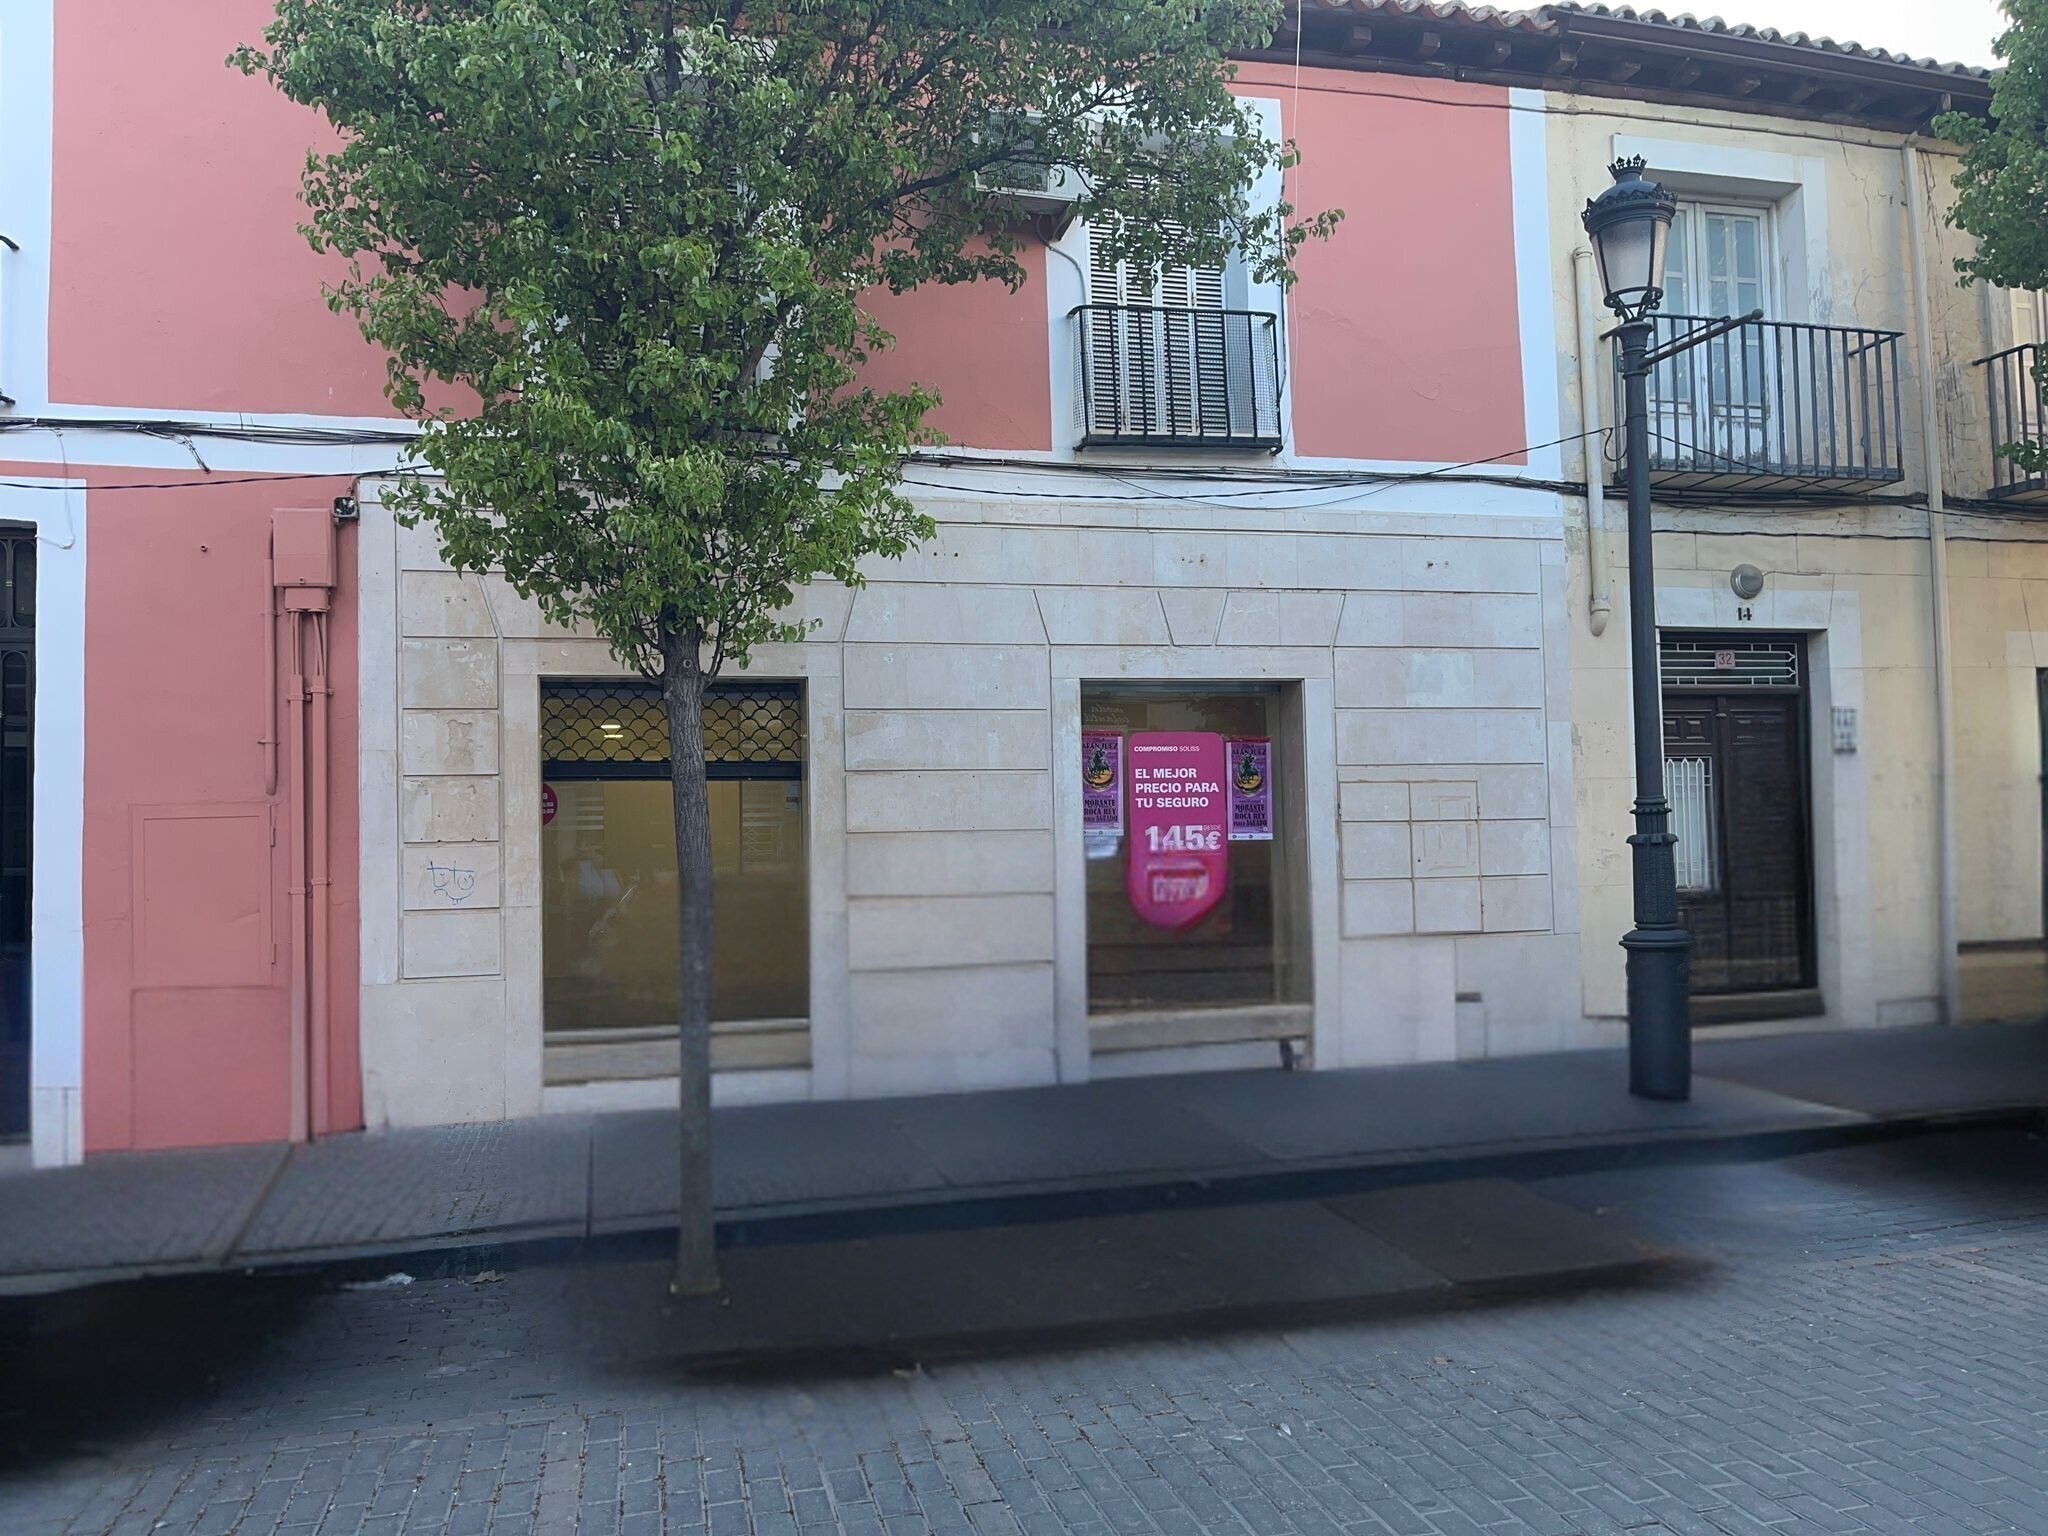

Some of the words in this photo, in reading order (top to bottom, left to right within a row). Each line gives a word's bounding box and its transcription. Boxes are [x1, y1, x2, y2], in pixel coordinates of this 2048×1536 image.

[1737, 607, 1752, 621] 14
[1718, 652, 1733, 665] 32
[1135, 768, 1150, 779] EL
[1153, 768, 1197, 779] MEJOR
[1135, 783, 1182, 794] PRECIO
[1185, 782, 1219, 793] PARA
[1085, 799, 1116, 807] MORANTE
[1135, 798, 1153, 808] TU
[1156, 797, 1209, 808] SEGURO
[1235, 803, 1265, 812] MORANTE
[1084, 808, 1101, 816] ROCA
[1103, 808, 1117, 816] REY
[1234, 812, 1251, 820] ROCA
[1253, 812, 1266, 820] REY
